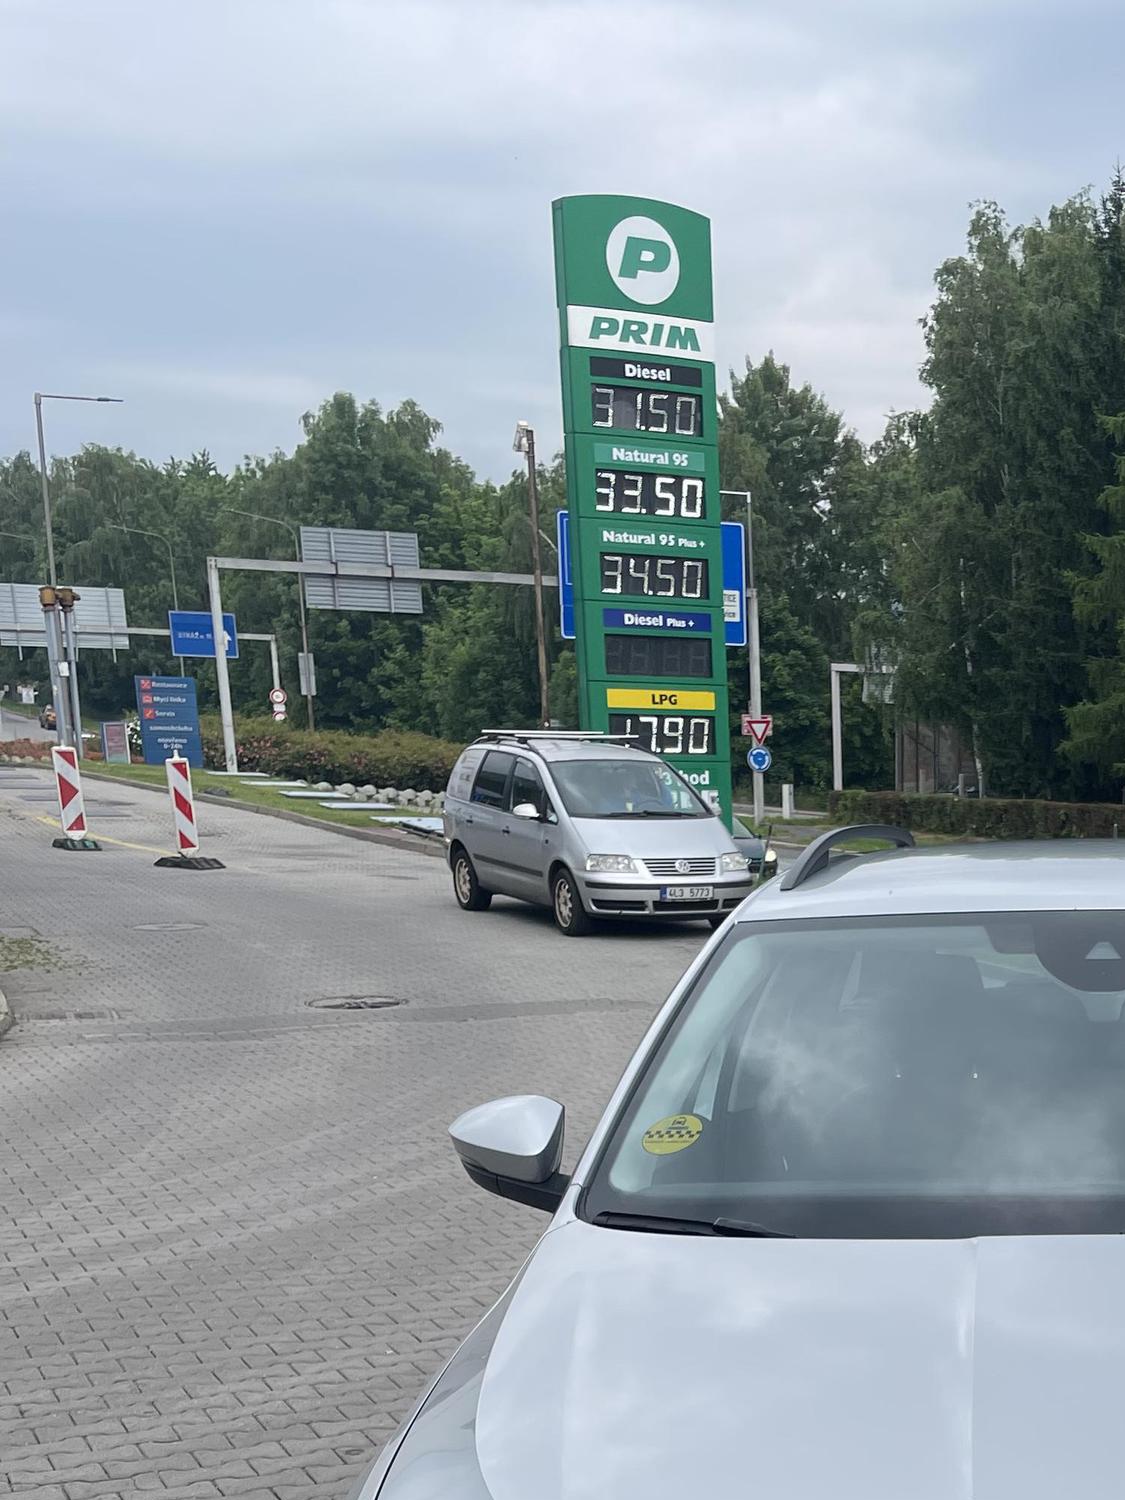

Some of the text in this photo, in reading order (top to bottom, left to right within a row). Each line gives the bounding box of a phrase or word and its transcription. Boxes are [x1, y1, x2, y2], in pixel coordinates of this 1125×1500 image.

[589, 316, 701, 352] PRIM
[624, 363, 671, 381] Diesel
[592, 388, 696, 435] 31.50
[612, 448, 688, 466] Natural 95
[595, 471, 703, 518] 33.50
[602, 530, 655, 547] Natural
[659, 534, 675, 547] 95
[678, 539, 697, 548] Plus
[601, 556, 702, 597] 34.50
[623, 613, 663, 627] Diesel
[666, 618, 686, 628] Plus
[651, 693, 678, 705] LPG
[689, 887, 710, 897] 5773
